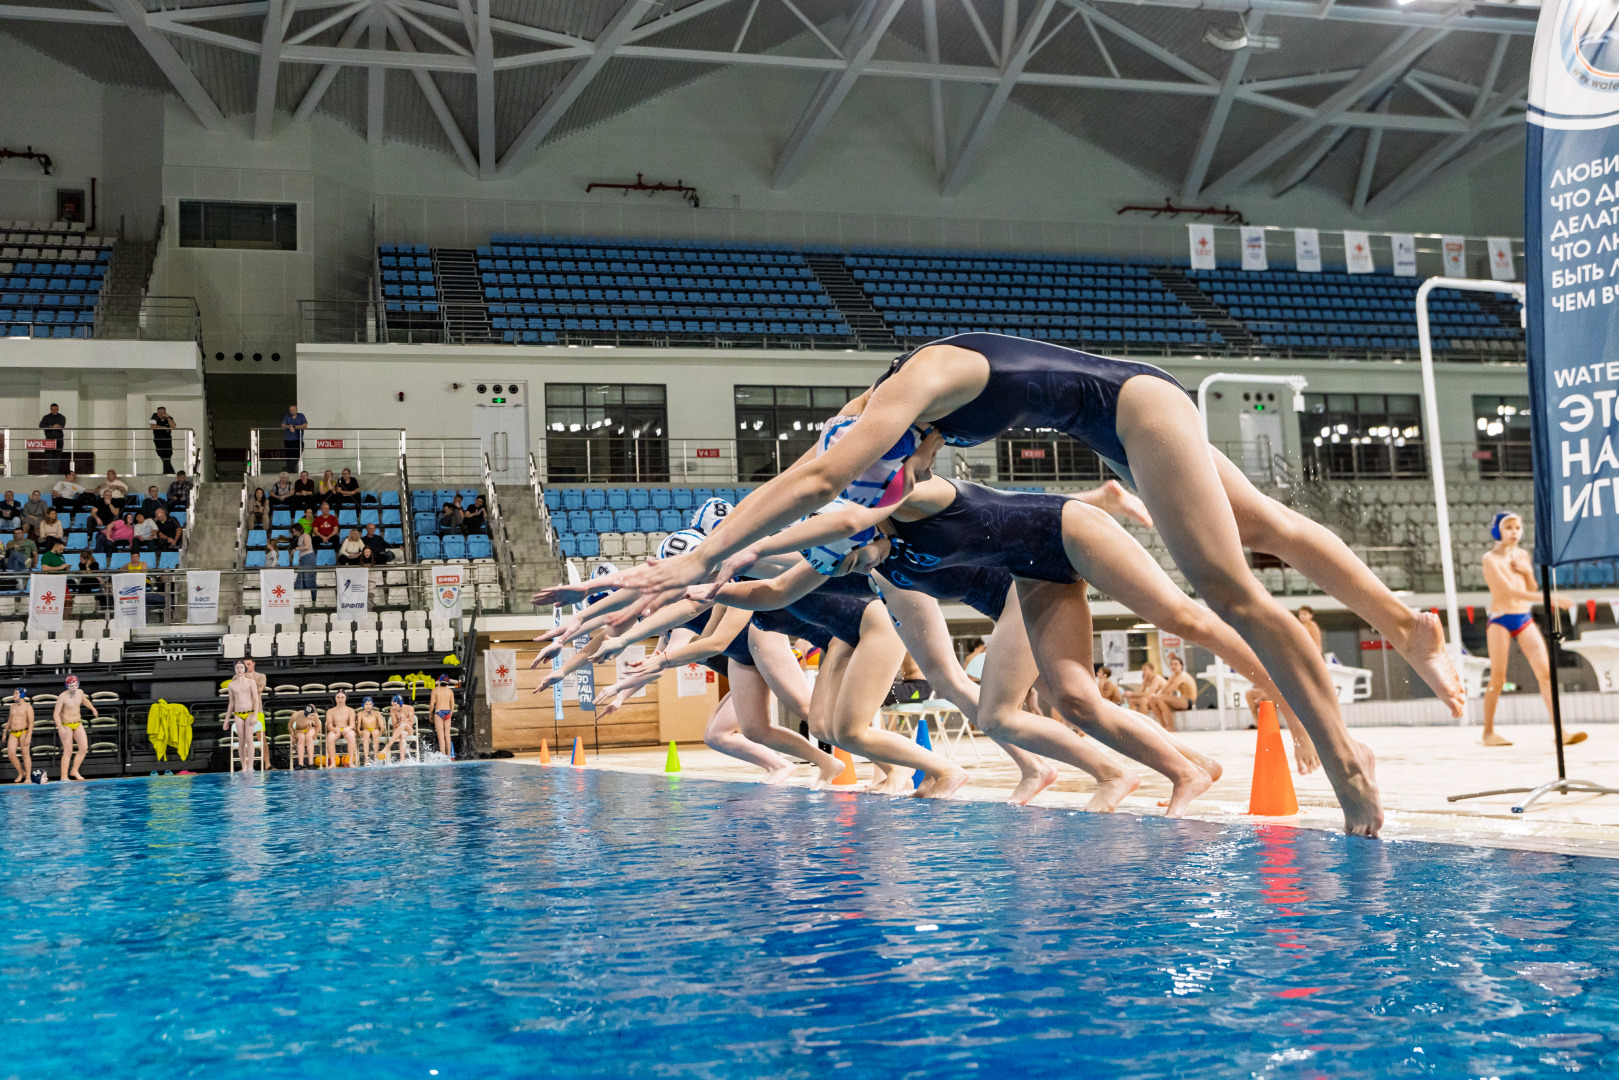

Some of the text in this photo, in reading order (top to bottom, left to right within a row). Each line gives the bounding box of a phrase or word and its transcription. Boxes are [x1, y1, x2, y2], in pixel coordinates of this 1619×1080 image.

[1550, 188, 1591, 212] ЧТО
[1551, 239, 1591, 262] ЧТО
[1552, 262, 1605, 289] БЫТЬ
[1551, 288, 1596, 313] ЧЕМ
[1553, 361, 1619, 389] WATE
[1558, 390, 1619, 433] ЭТ
[317, 440, 334, 448] W3L
[1561, 434, 1619, 478] НА
[714, 502, 727, 517] 8
[1604, 670, 1613, 688] 5
[1233, 692, 1240, 707] 8
